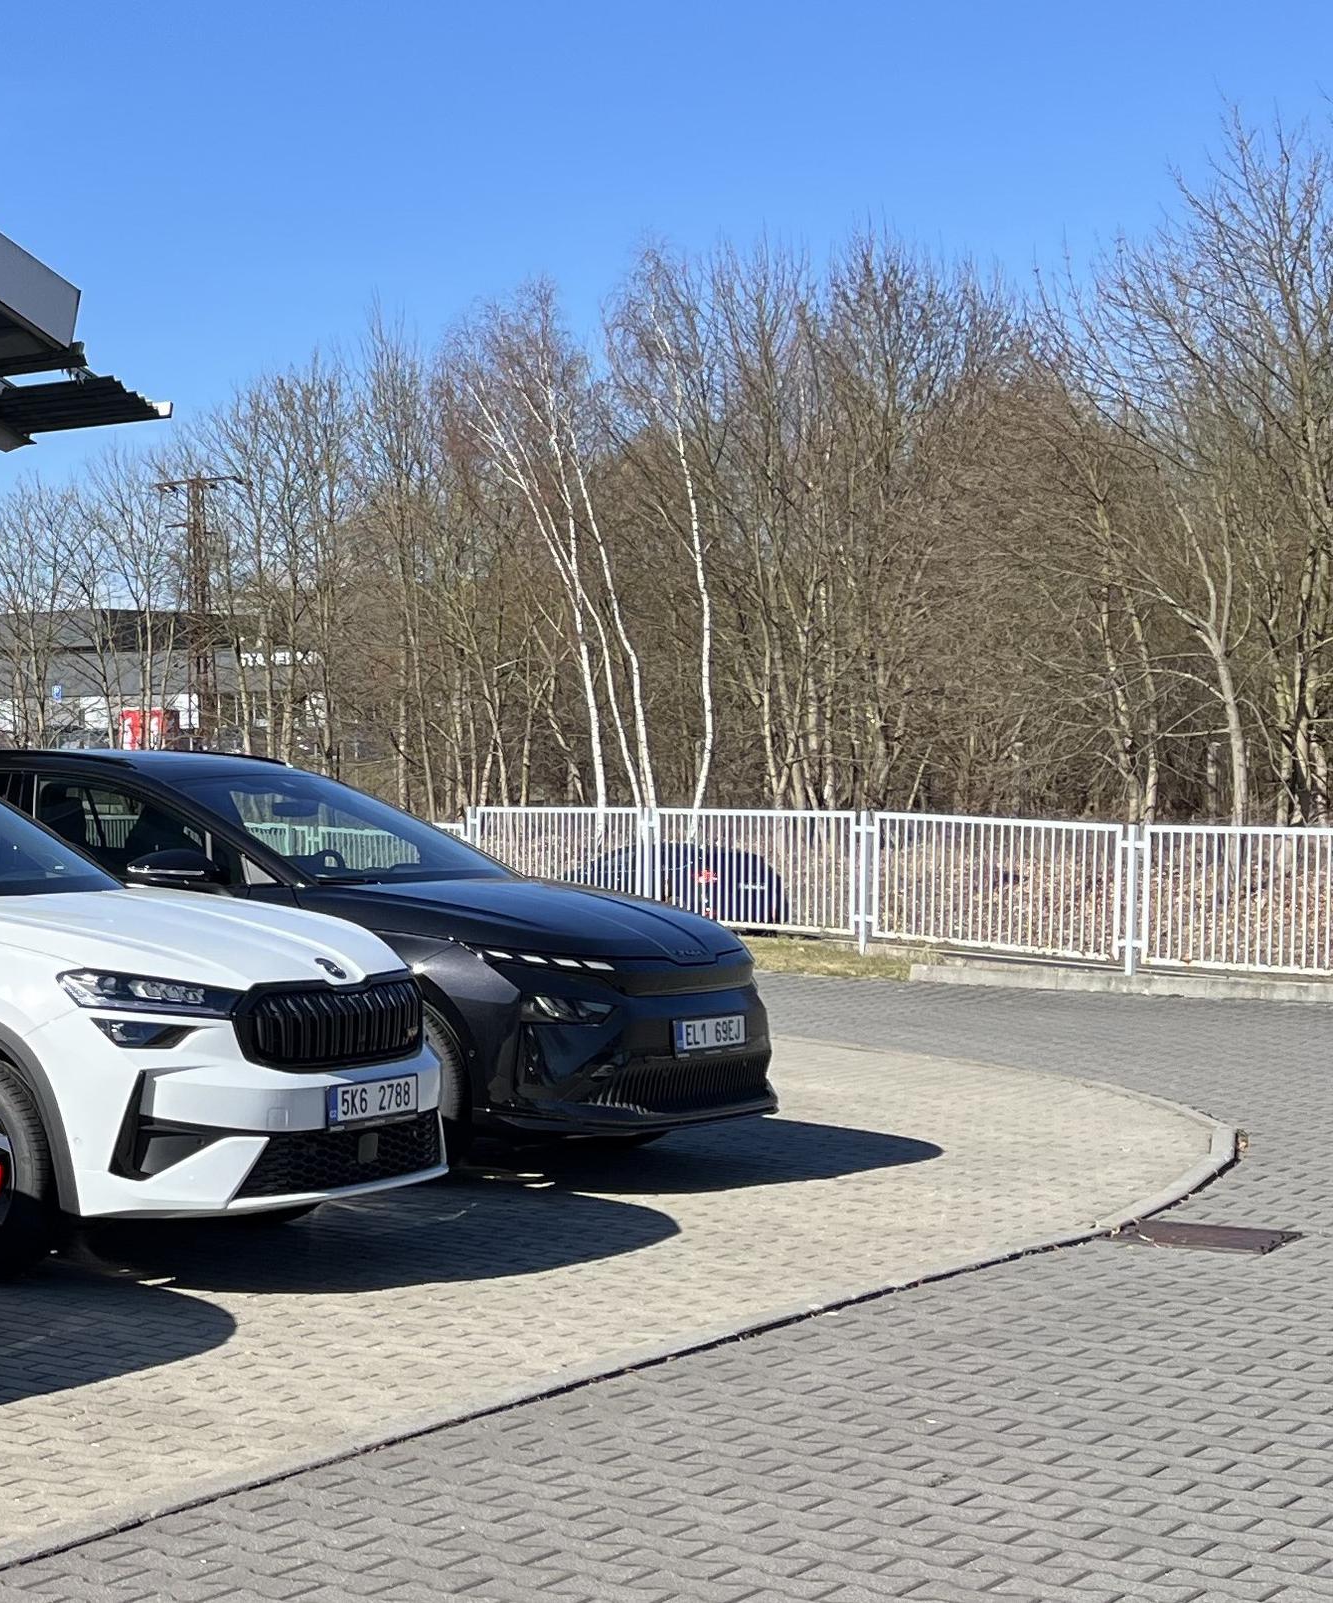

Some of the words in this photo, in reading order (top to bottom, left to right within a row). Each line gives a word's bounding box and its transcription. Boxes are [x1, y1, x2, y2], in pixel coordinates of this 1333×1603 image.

[685, 1022, 708, 1046] EL1
[714, 1018, 741, 1043] 69EJ
[341, 1087, 368, 1116] 5K6
[378, 1080, 411, 1112] 2788
